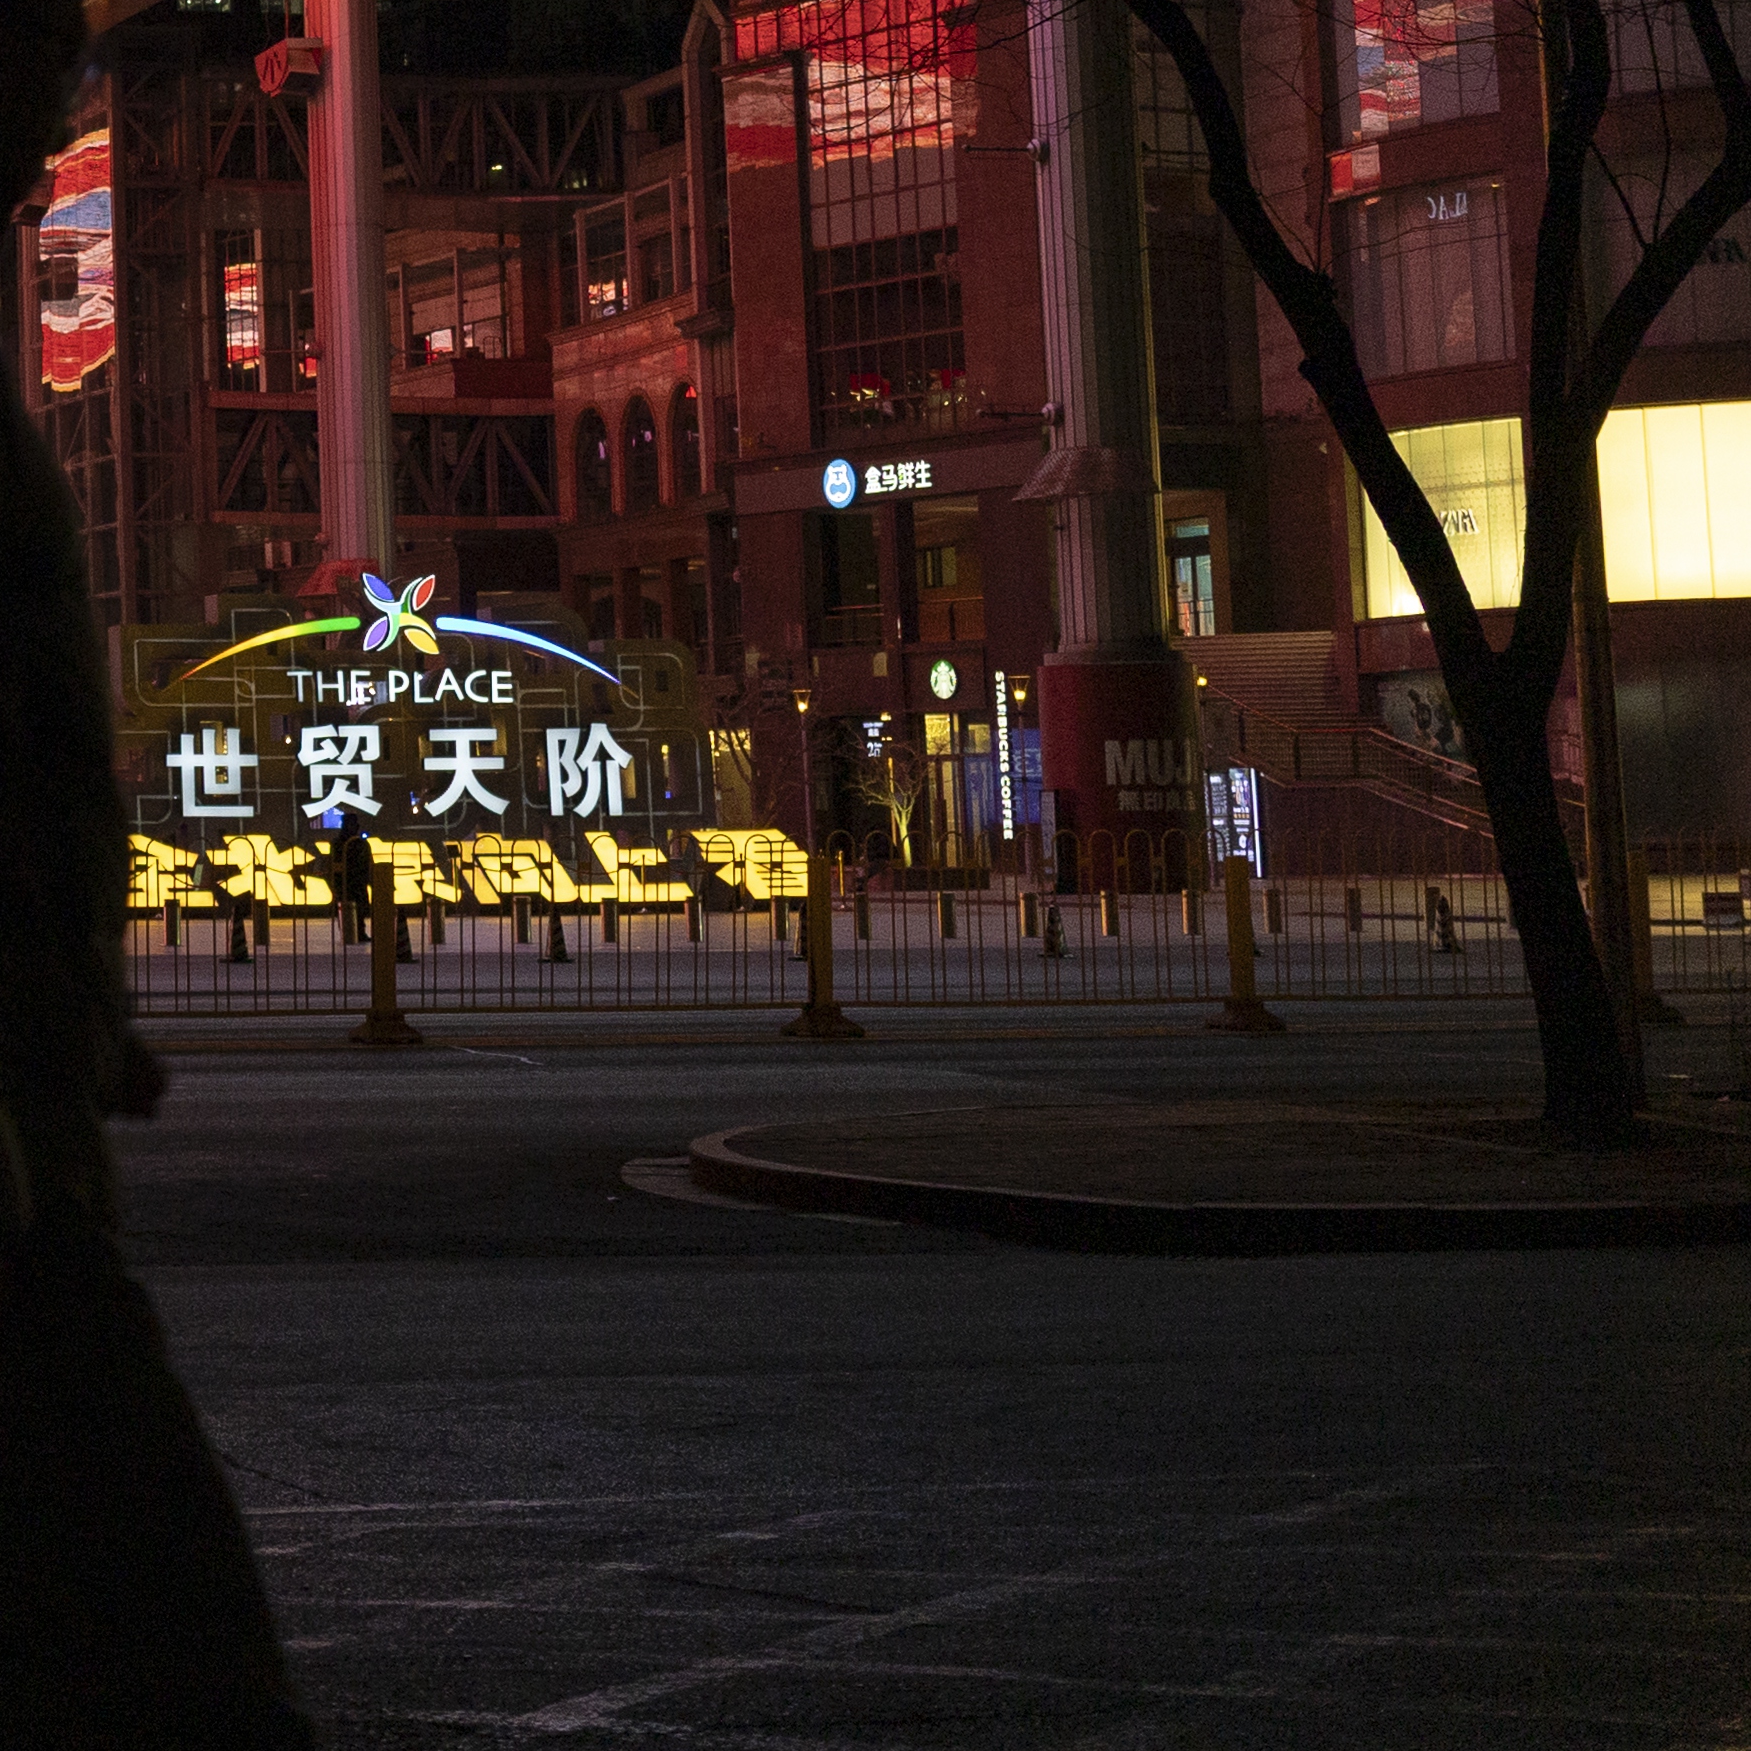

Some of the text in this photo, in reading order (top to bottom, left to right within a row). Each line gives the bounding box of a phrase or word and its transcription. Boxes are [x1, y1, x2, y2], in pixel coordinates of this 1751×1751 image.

[864, 459, 933, 495] 盒马鲜生
[286, 669, 514, 706] THE PLACE
[165, 722, 634, 820] 世贸天阶
[994, 670, 1014, 841] STARBUCKS COFFEE
